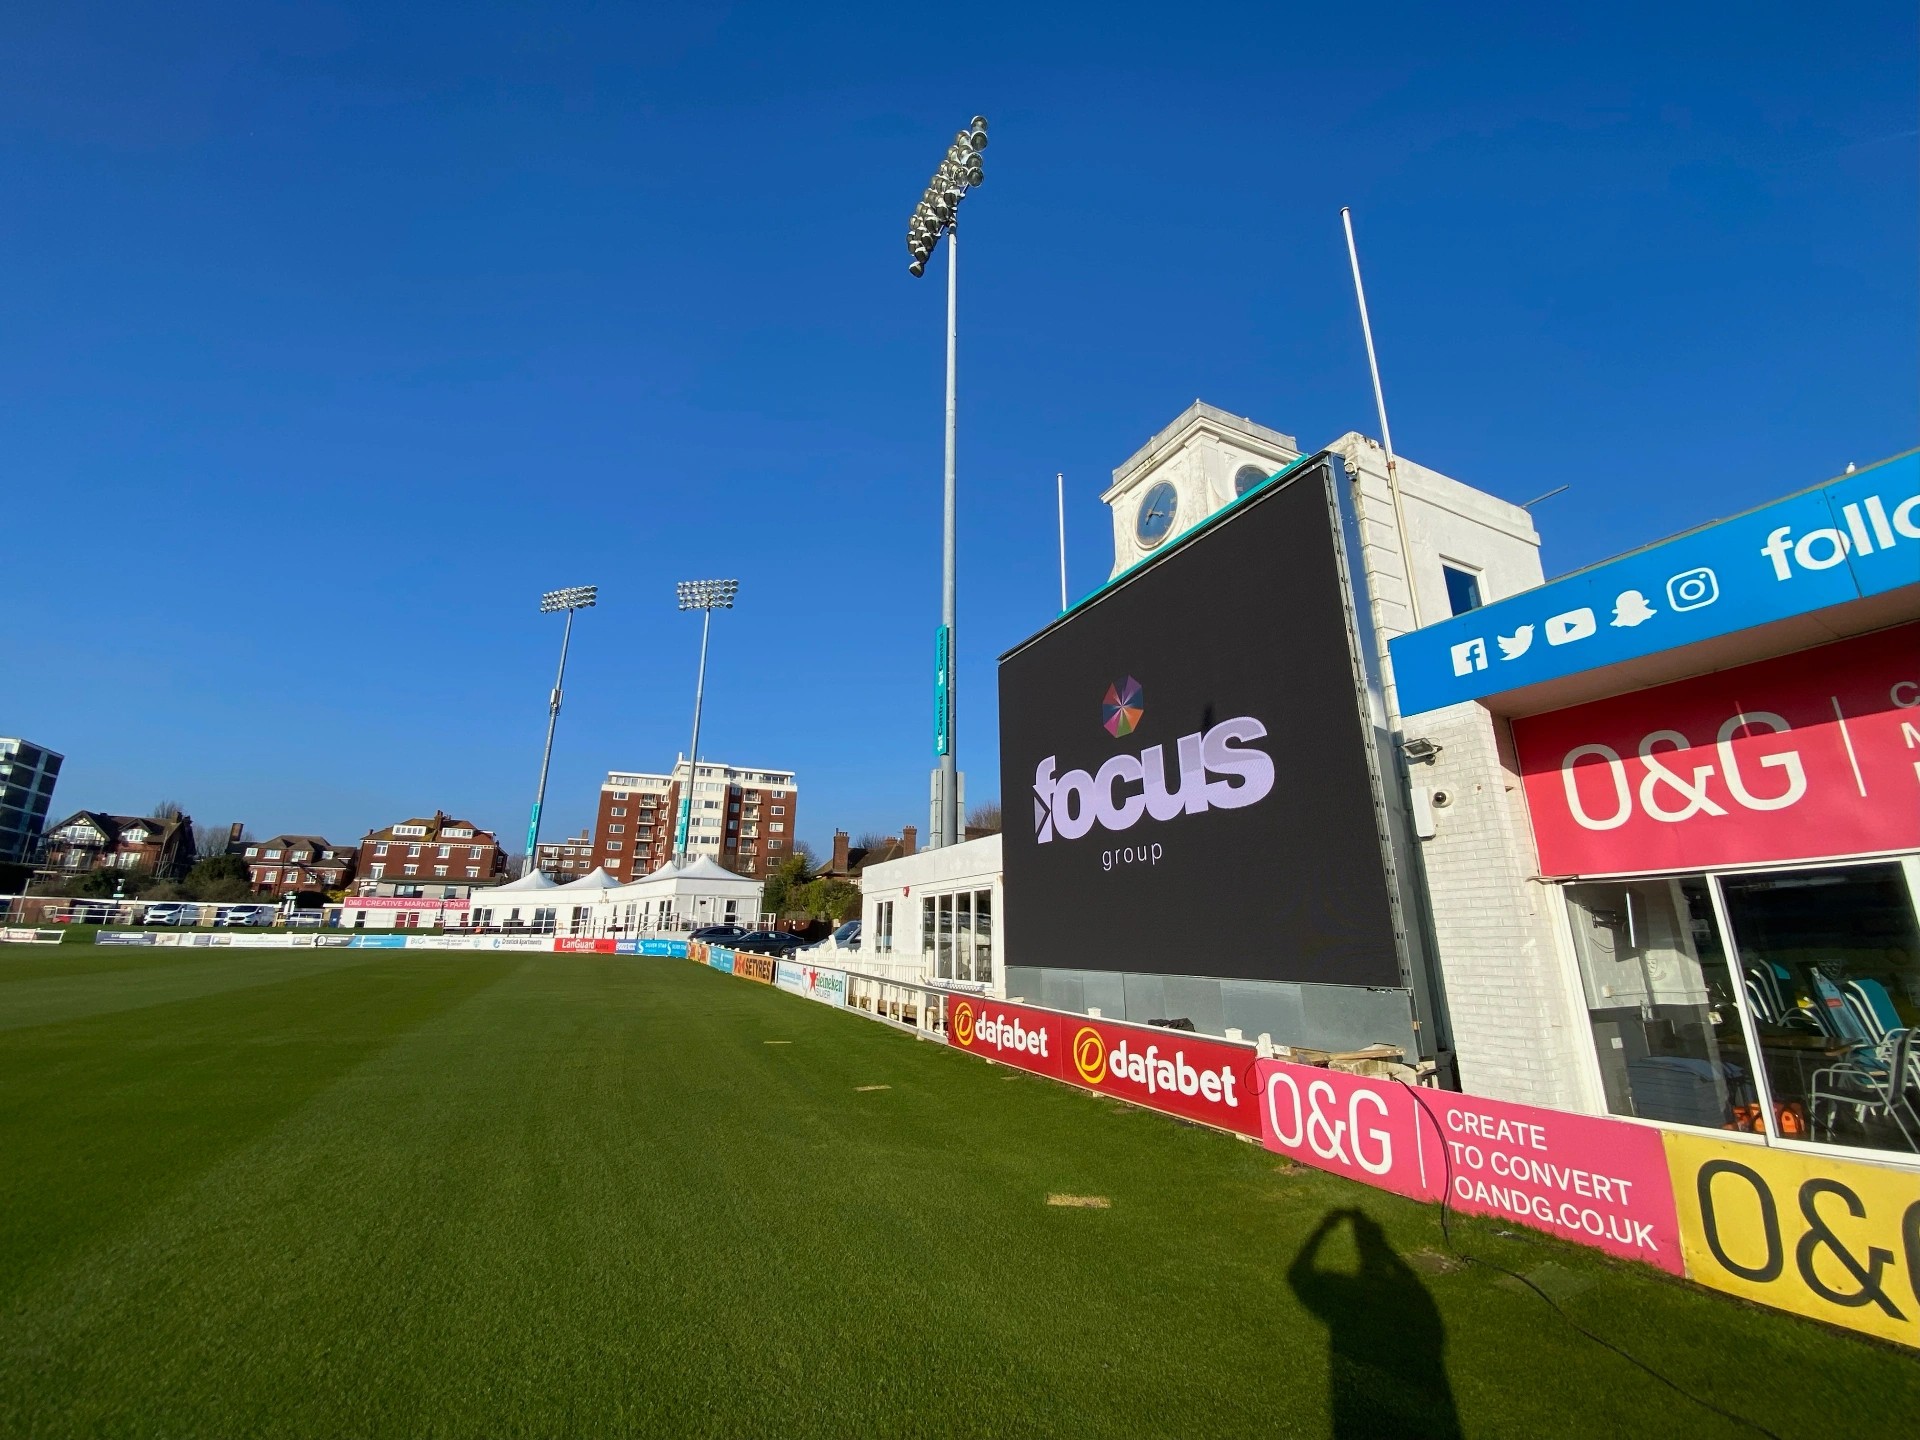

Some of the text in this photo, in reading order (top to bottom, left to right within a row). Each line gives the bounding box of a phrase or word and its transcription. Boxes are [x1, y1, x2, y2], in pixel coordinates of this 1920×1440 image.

[1033, 716, 1275, 844] focus
[1561, 711, 1808, 831] O&G
[1102, 842, 1163, 871] group
[562, 939, 595, 949] LanGuard
[745, 957, 771, 981] SETYRES
[816, 971, 843, 993] Heineken
[975, 1010, 1049, 1058] dafabet
[1109, 1039, 1239, 1107] dafabet
[1267, 1072, 1393, 1175] O&G
[1446, 1109, 1548, 1151] CREATE
[1449, 1141, 1632, 1206] TO CONVERT
[1454, 1176, 1659, 1252] OANDG.CO.UK
[1696, 1158, 1920, 1323] O&
